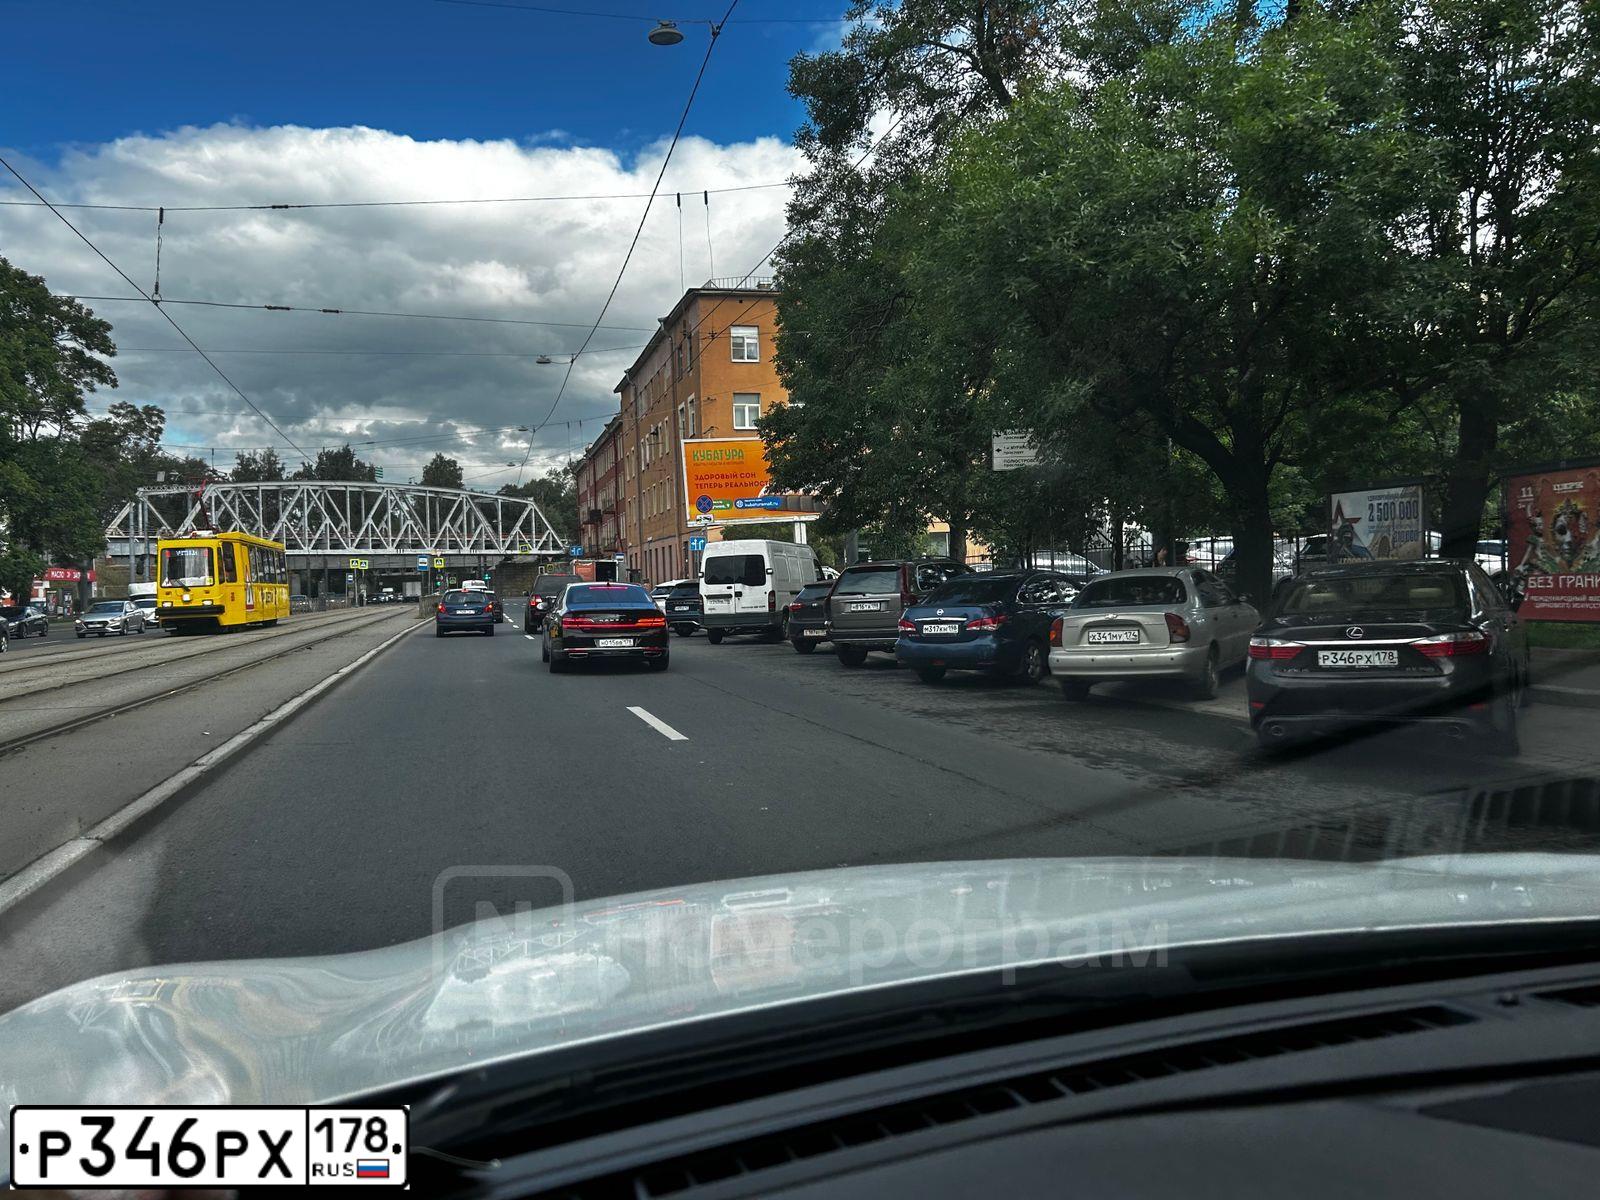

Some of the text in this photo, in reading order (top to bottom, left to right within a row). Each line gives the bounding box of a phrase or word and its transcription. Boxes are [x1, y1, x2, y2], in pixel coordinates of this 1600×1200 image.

[693, 449, 745, 461] КУБАТУРА
[695, 472, 738, 480] ЗДОРОВЫЙ
[725, 480, 771, 488] РЕАЛЬНОСТ
[1527, 575, 1554, 589] БЕЗ
[1375, 651, 1394, 662] 178
